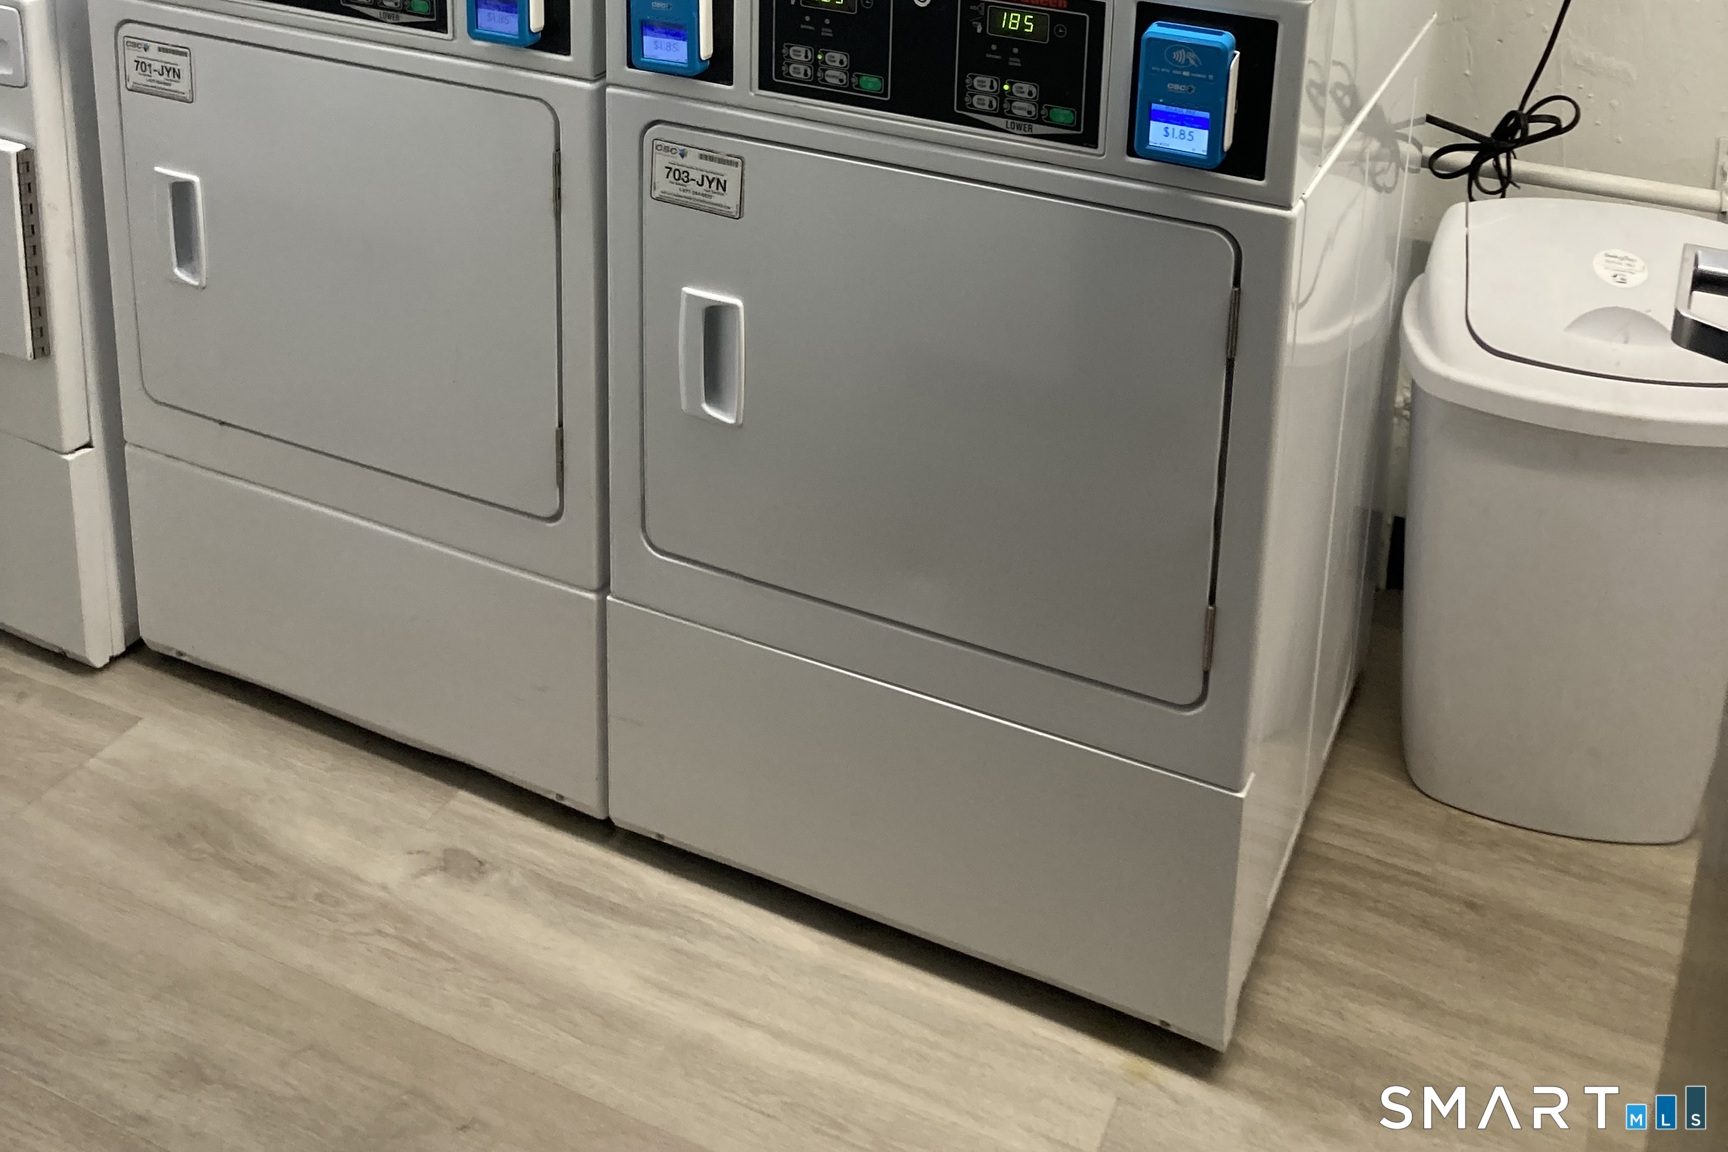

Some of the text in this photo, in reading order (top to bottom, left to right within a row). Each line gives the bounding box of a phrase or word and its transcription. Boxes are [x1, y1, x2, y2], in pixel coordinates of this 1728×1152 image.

[1001, 11, 1034, 33] 185
[653, 40, 679, 52] $185
[134, 59, 181, 80] 701-JYN
[1005, 120, 1033, 133] LOWER
[1163, 126, 1195, 142] $1.85
[655, 144, 678, 155] CSC
[664, 166, 727, 193] 703-JYN
